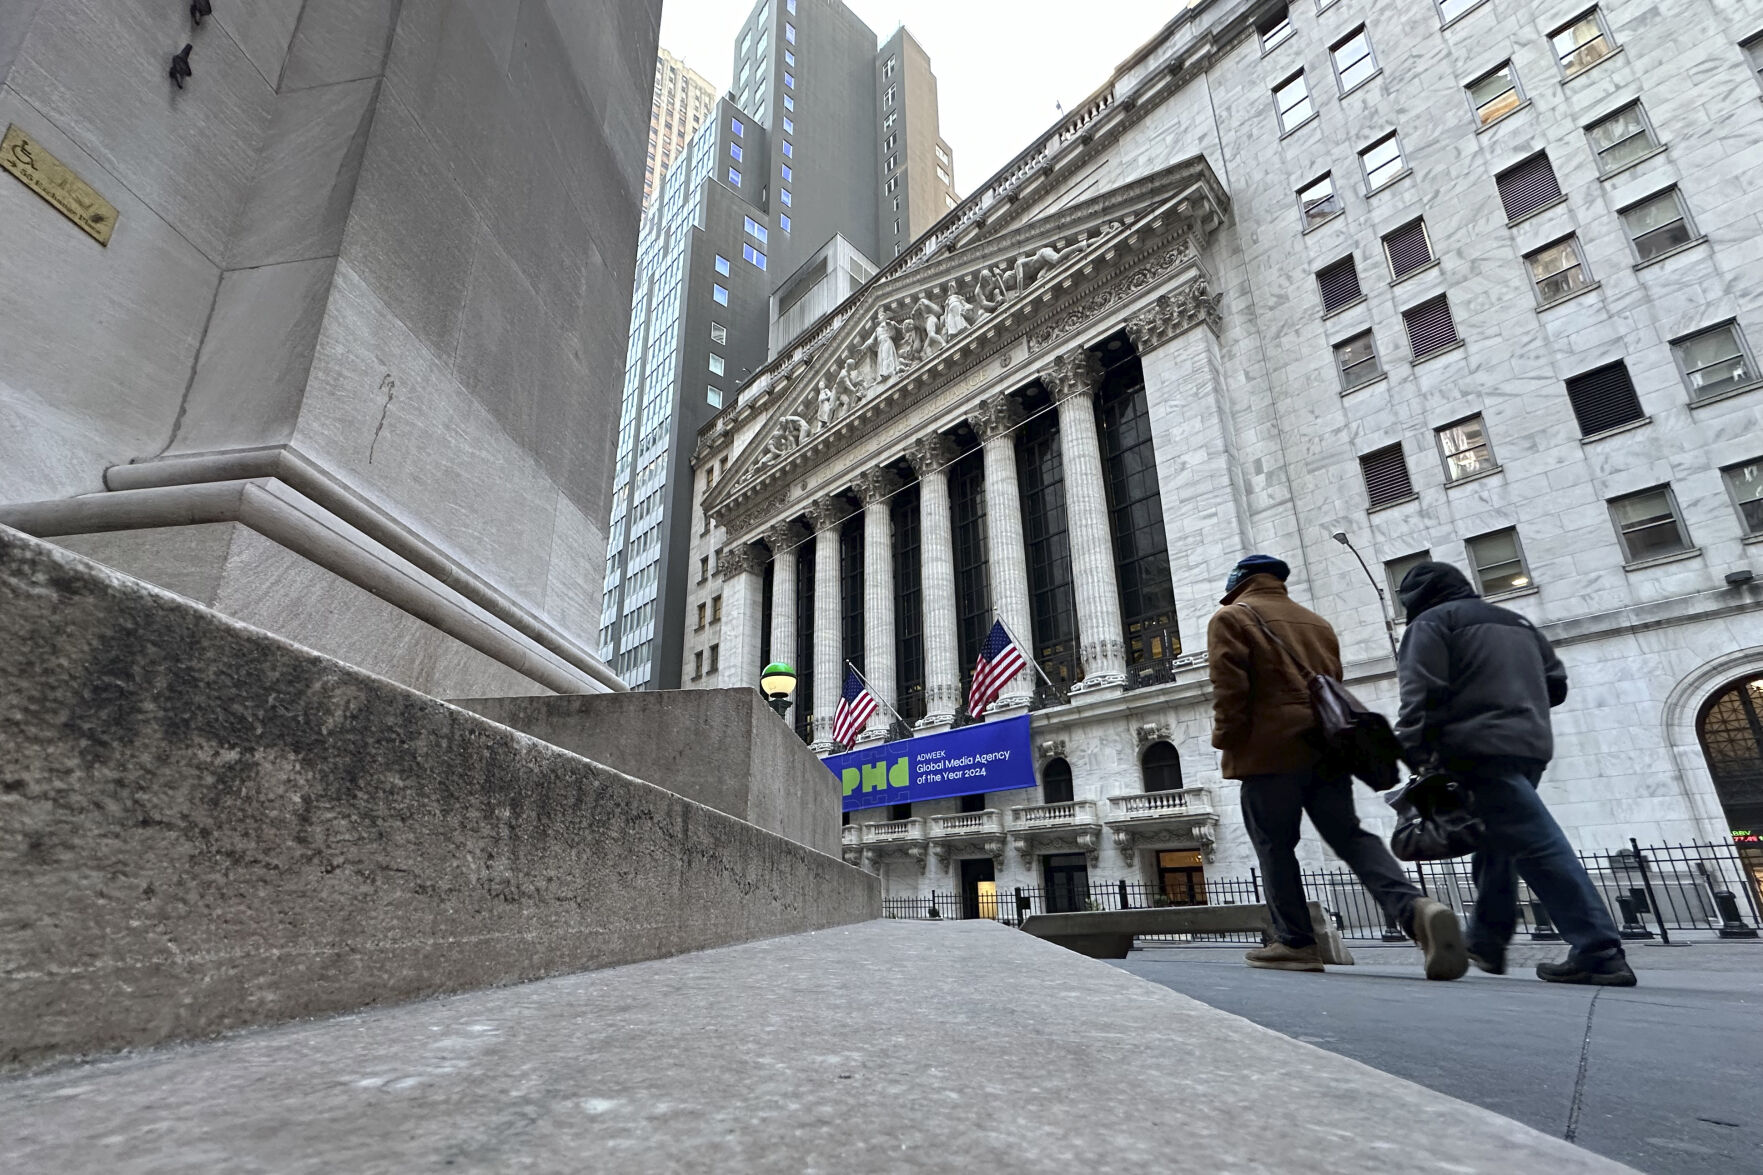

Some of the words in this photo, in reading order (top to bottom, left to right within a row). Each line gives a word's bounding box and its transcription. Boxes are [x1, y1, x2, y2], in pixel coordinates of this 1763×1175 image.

[918, 369, 988, 419] EXCHANGE
[916, 750, 946, 762] ADWEEK
[916, 760, 944, 773] Global
[945, 755, 973, 769] Media
[974, 750, 1011, 764] Agency
[916, 774, 926, 785] of
[927, 773, 941, 783] the
[942, 770, 963, 781] Year
[964, 767, 986, 779] 2024
